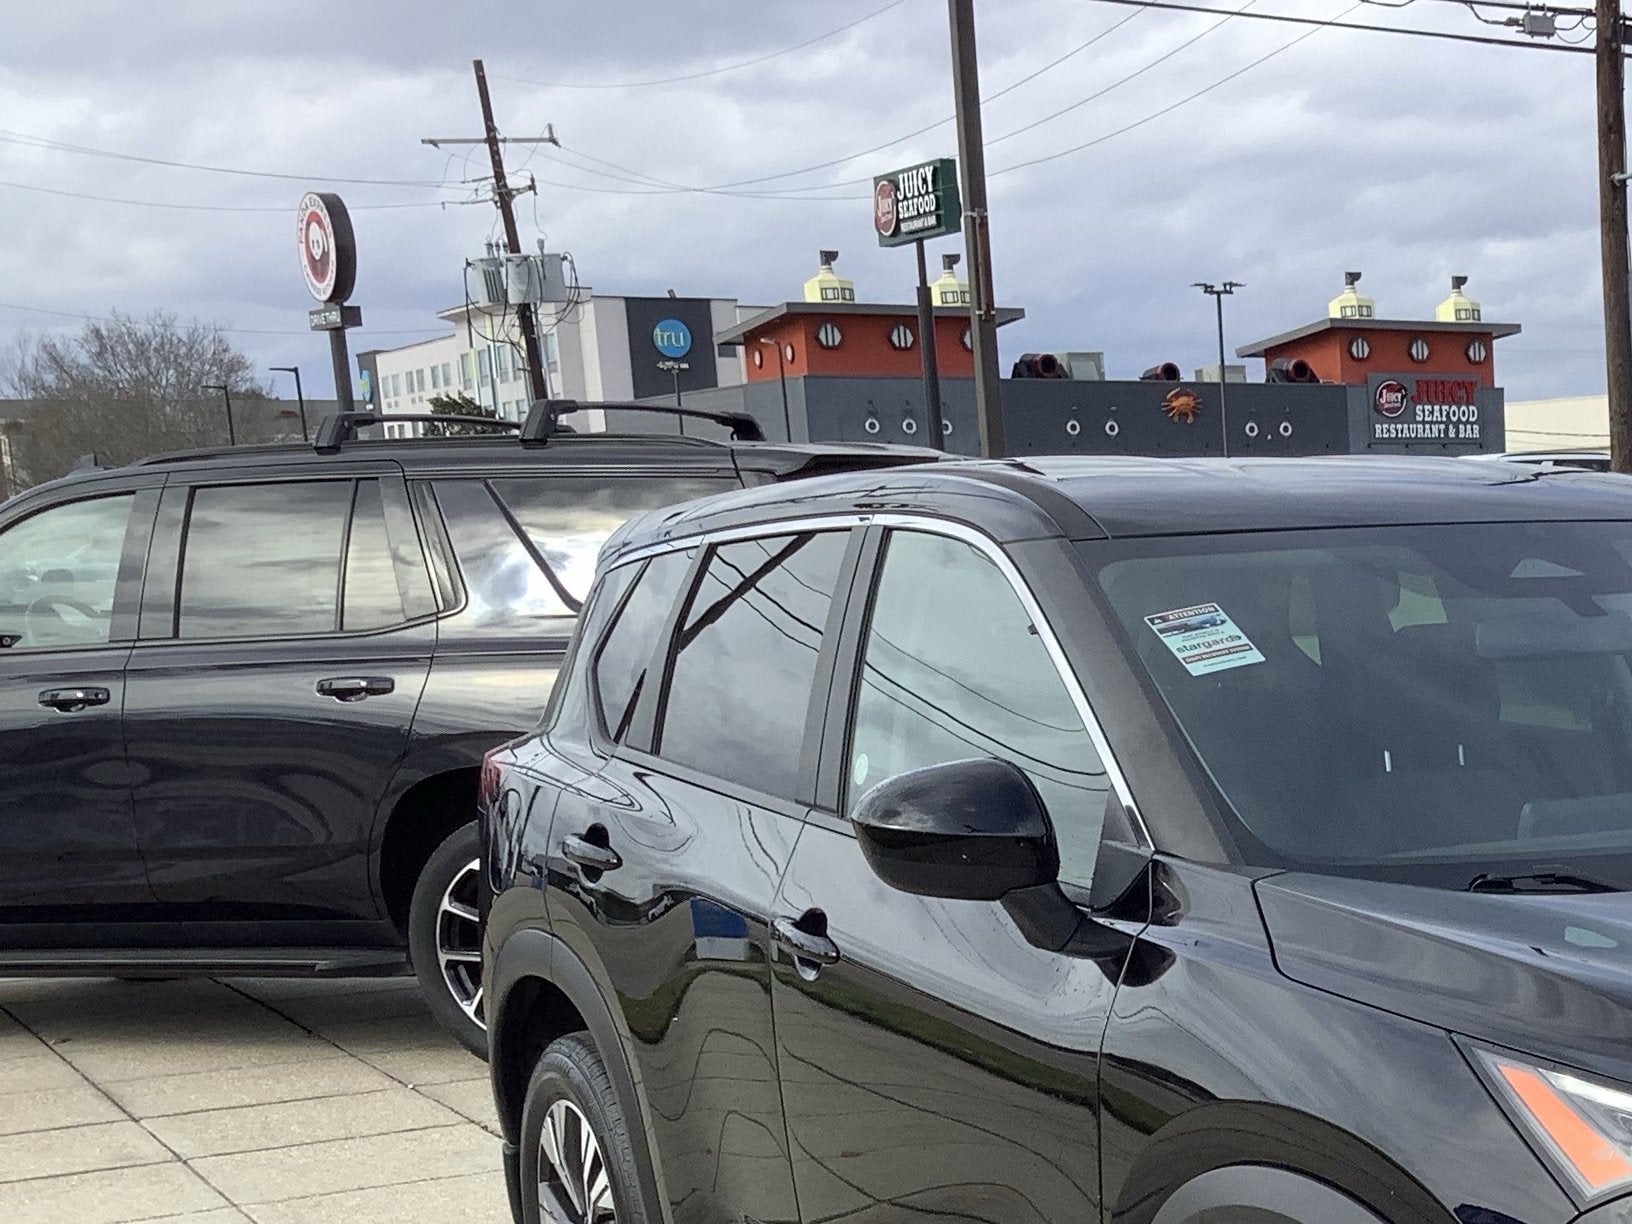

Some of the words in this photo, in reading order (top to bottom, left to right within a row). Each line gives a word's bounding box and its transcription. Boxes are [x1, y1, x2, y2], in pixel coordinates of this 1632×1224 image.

[896, 165, 934, 200] JUICY
[897, 193, 936, 219] SEAFOOD
[655, 328, 684, 347] tru
[1411, 379, 1477, 404] JUICY
[1415, 405, 1478, 422] SEAFOOD
[1375, 424, 1446, 438] RESTAURANT
[1448, 425, 1456, 438] &
[1458, 424, 1480, 438] BAR
[1167, 606, 1216, 620] ATTENTION
